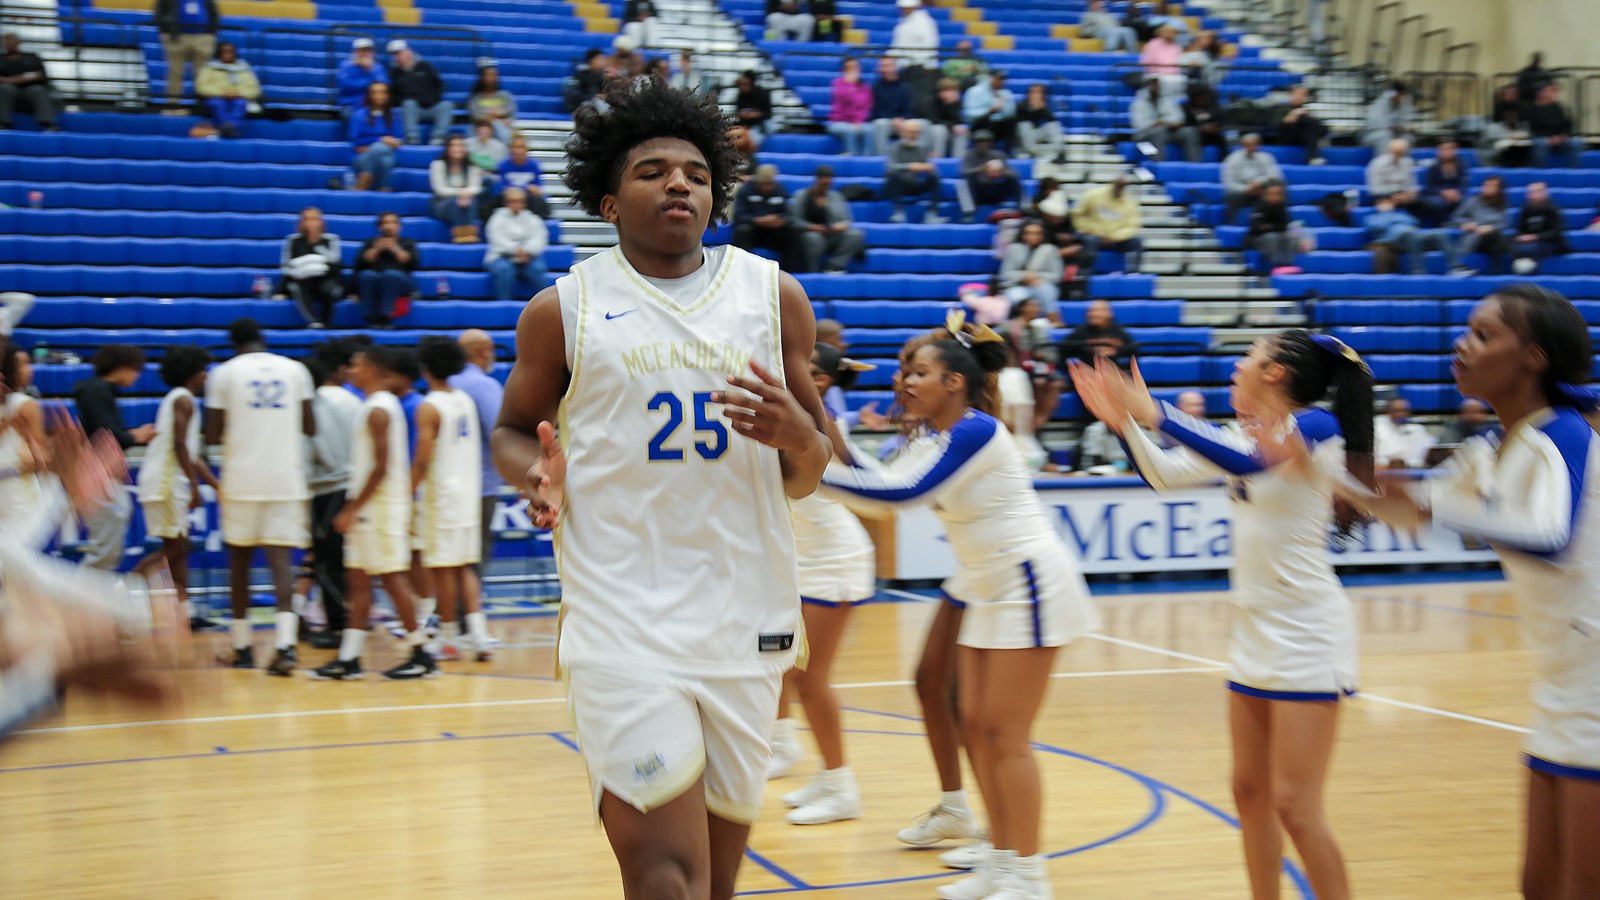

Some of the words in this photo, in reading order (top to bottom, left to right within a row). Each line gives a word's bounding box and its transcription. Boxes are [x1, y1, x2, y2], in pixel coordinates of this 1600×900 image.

[621, 341, 749, 380] MCEACHERN
[246, 379, 287, 409] 32
[646, 390, 731, 463] 25
